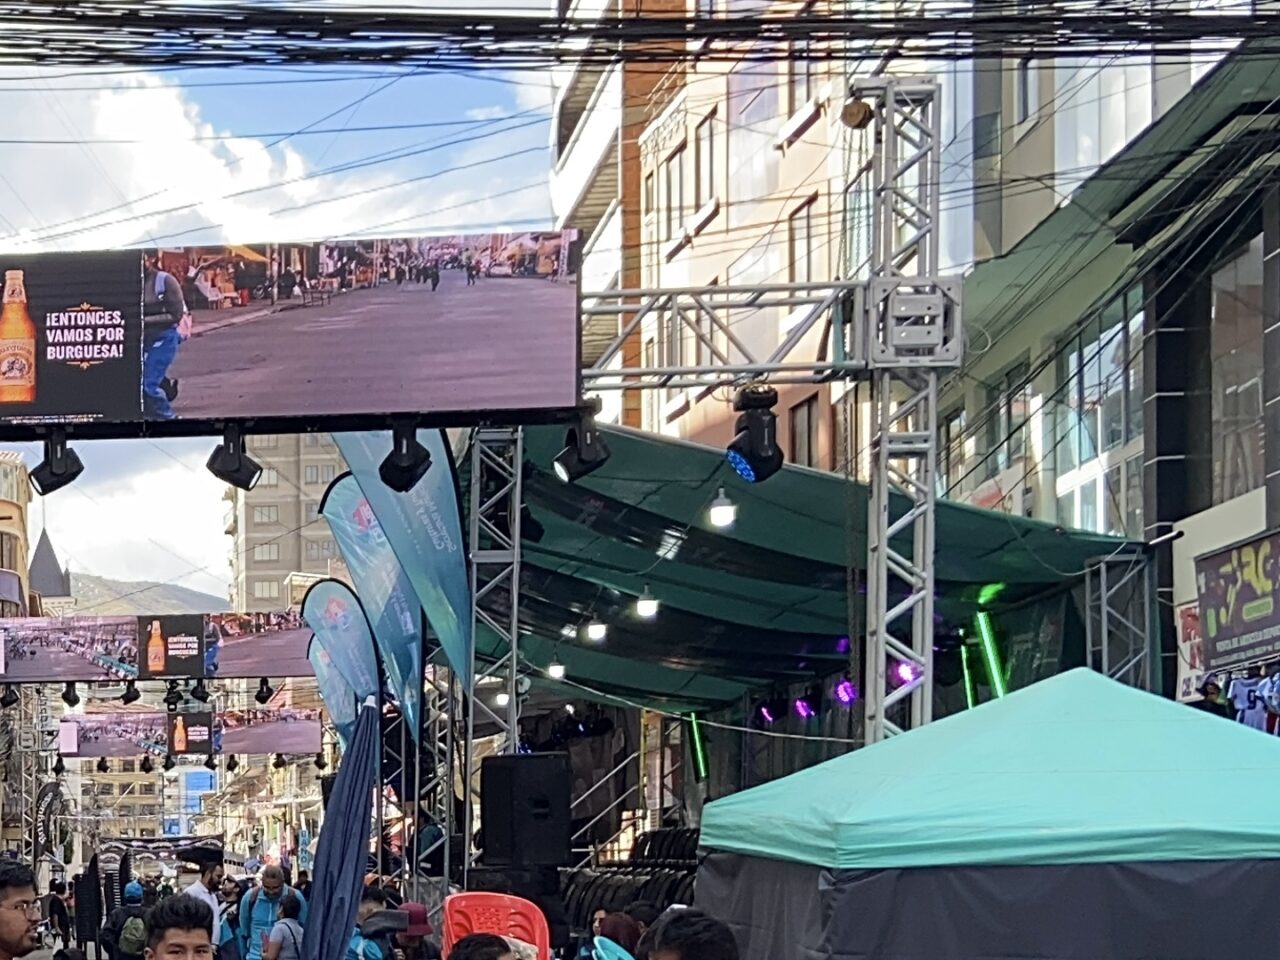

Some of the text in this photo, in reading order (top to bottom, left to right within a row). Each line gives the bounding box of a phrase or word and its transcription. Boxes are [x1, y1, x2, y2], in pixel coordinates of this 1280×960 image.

[46, 311, 125, 327] ¡ENTONCES,
[46, 327, 124, 343] VAMOS POR
[46, 344, 124, 360] BURGUESA!
